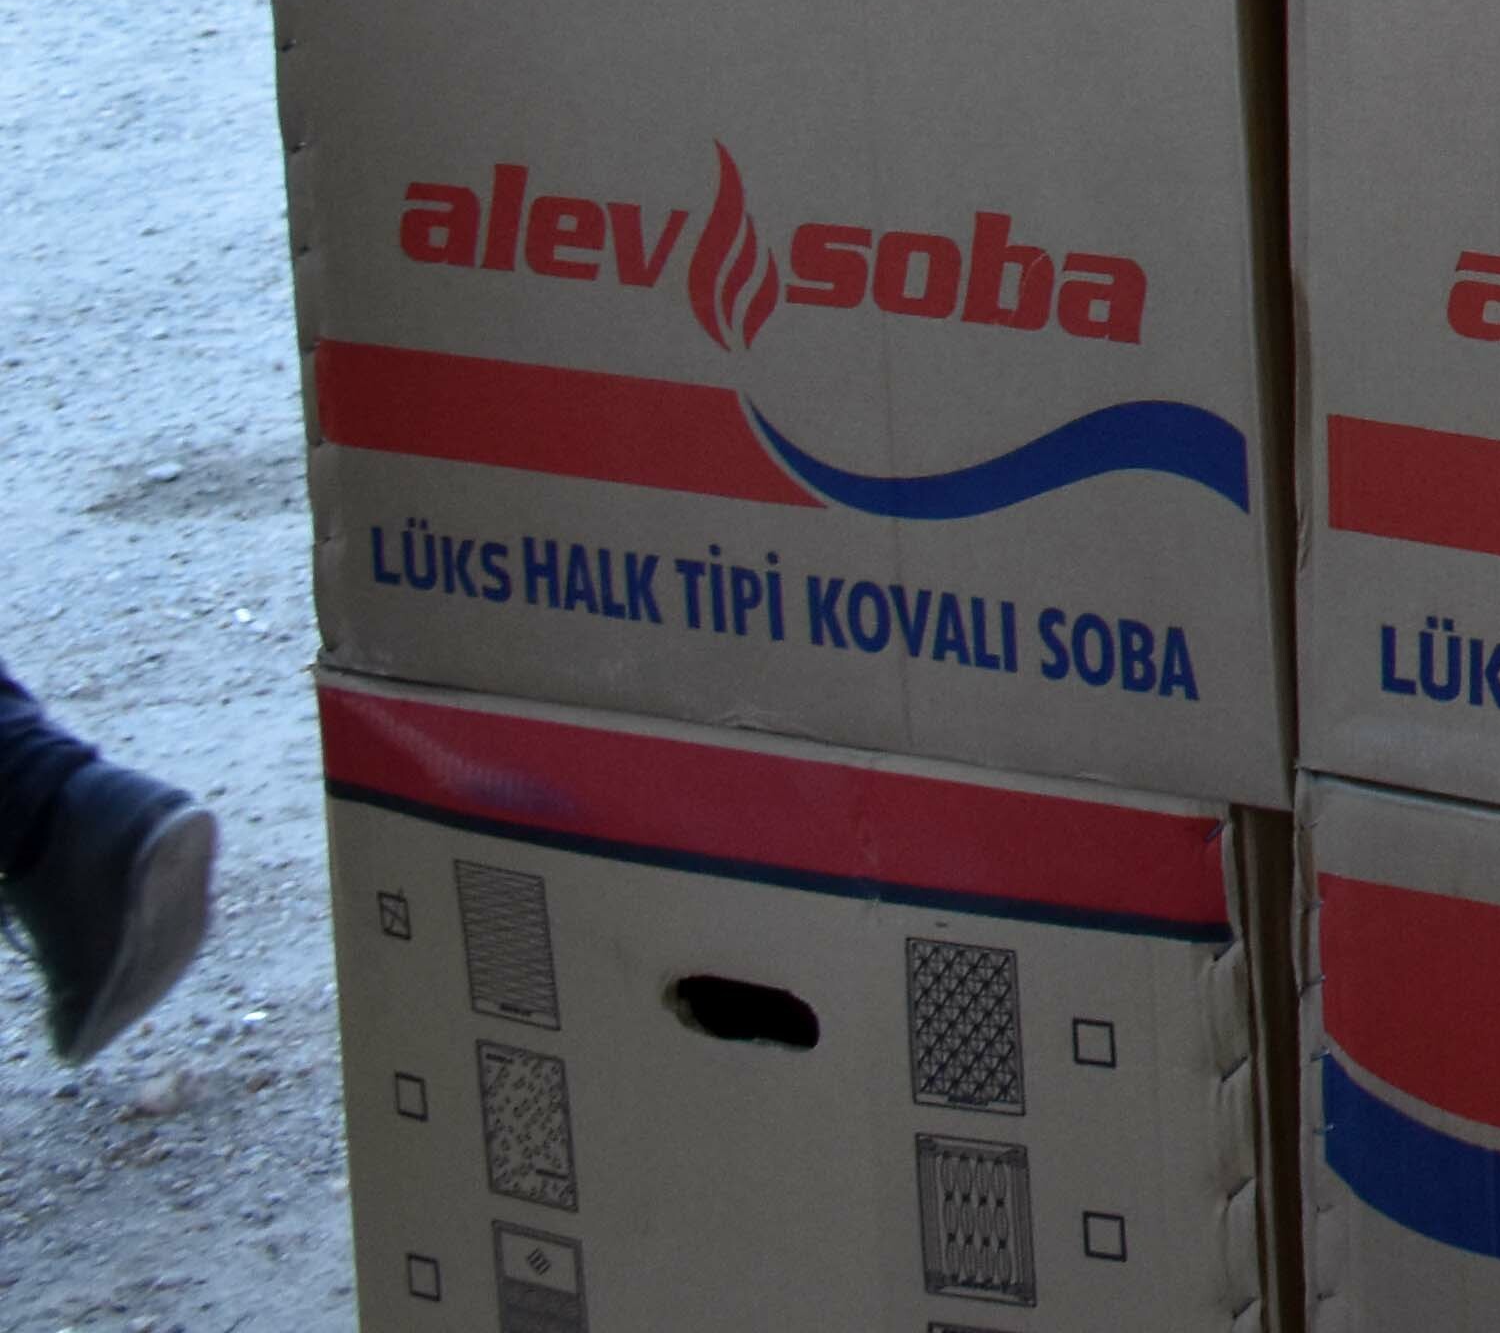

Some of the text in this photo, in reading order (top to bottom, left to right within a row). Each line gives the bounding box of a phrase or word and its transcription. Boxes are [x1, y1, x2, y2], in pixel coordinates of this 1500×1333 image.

[401, 162, 1148, 345] alev soba
[370, 516, 1201, 702] LÜKS HALK TİPİ KOVALI SOBA
